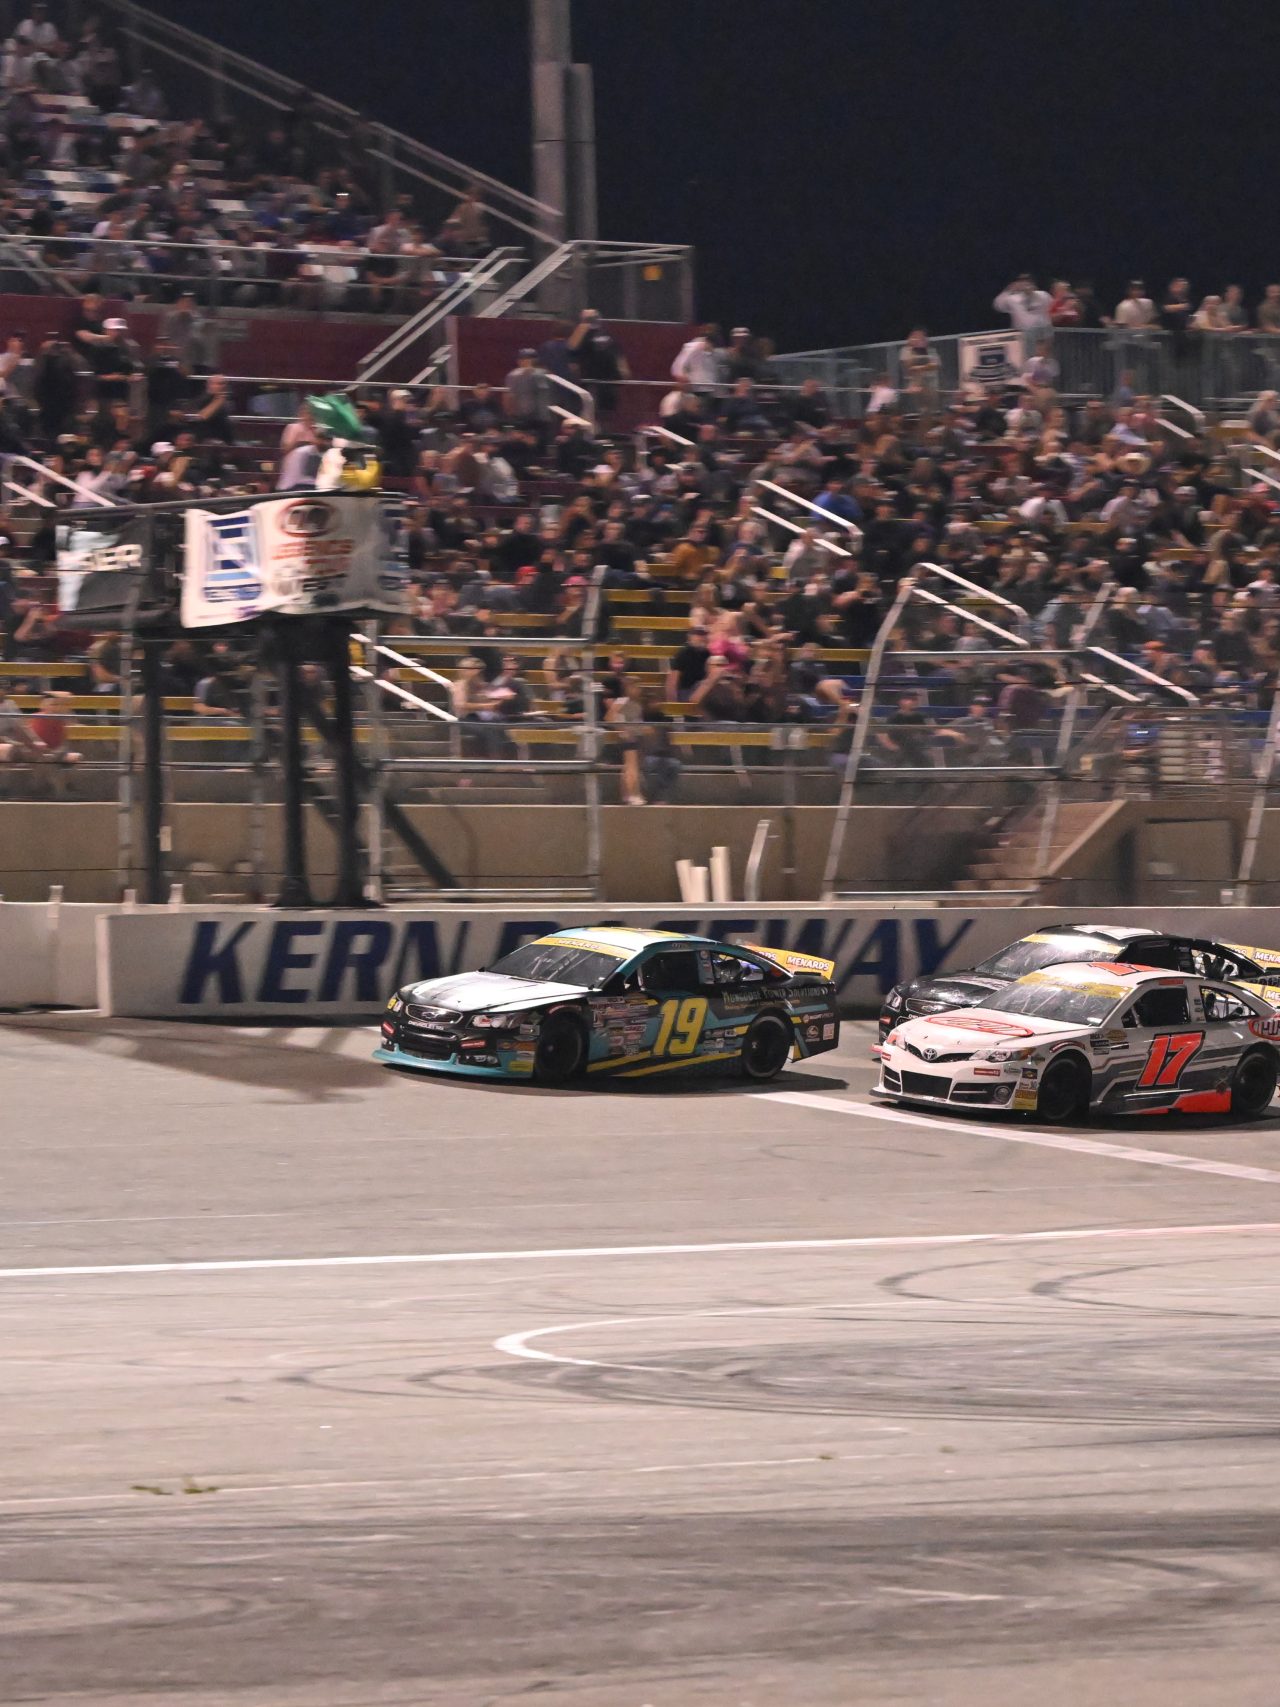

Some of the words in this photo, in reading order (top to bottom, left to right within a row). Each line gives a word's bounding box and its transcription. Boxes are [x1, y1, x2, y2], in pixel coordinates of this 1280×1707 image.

[178, 920, 471, 1003] KERN
[786, 955, 830, 972] MENARDS
[652, 997, 709, 1056] 19
[1136, 1031, 1205, 1089] 17
